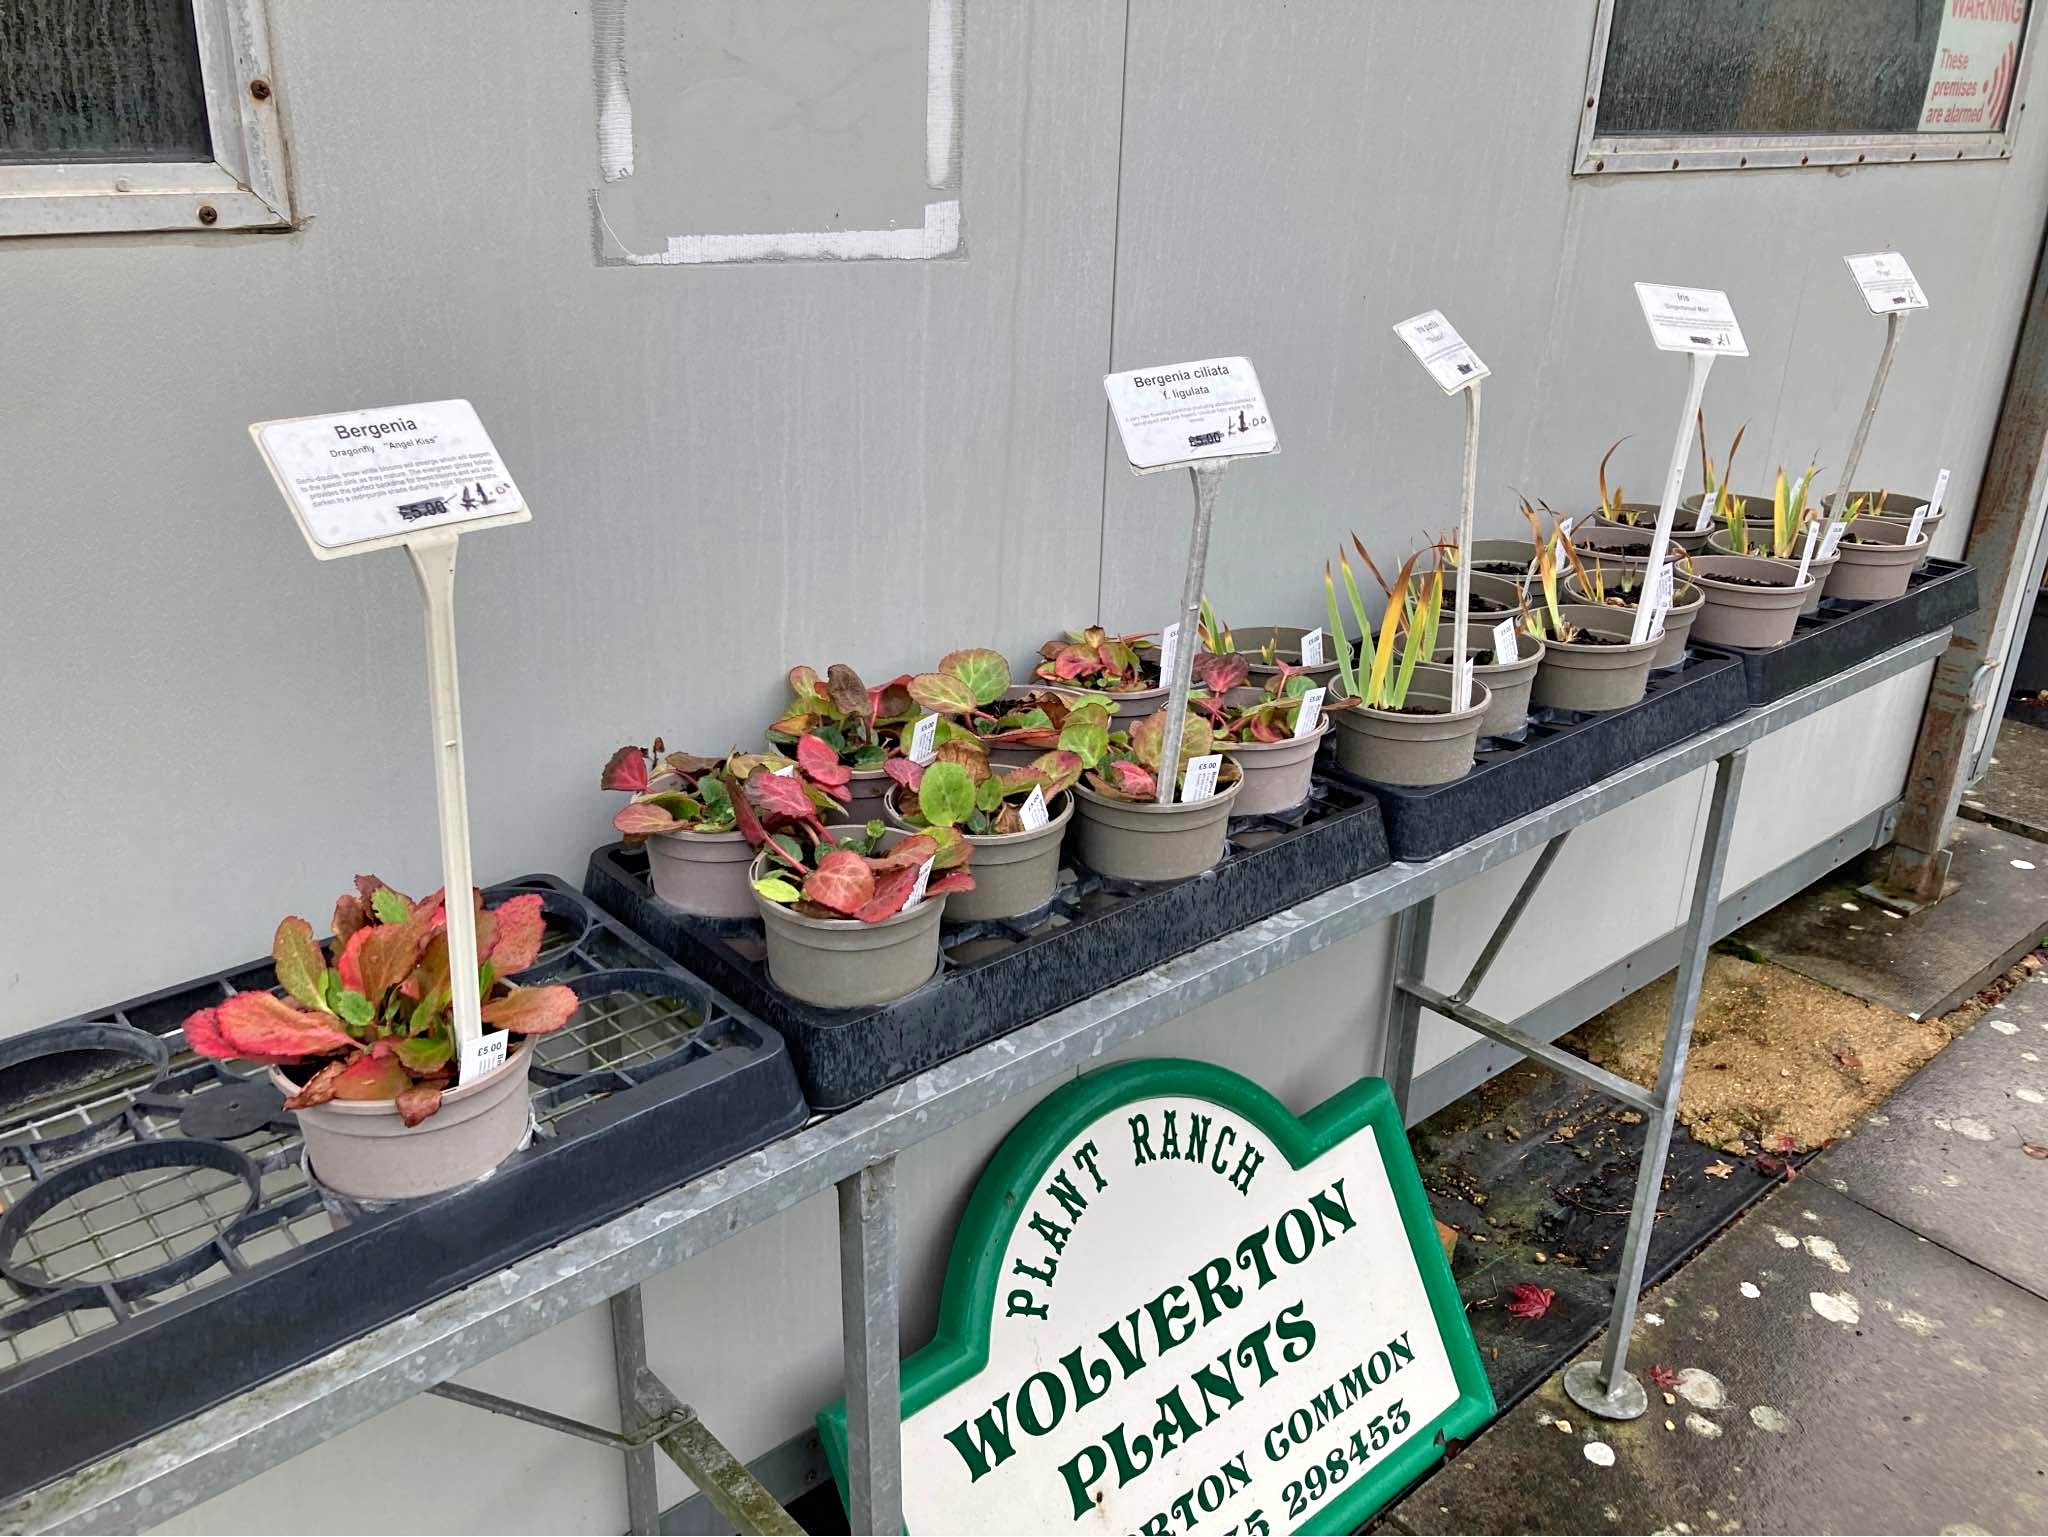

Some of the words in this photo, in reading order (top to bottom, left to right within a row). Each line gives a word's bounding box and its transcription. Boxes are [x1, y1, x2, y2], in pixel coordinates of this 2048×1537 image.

[1952, 0, 2021, 24] WARNING
[1941, 48, 1969, 70] These
[1931, 77, 1977, 101] premises
[1925, 107, 1943, 123] are
[1944, 103, 1984, 123] alarmed
[1134, 370, 1190, 388] Bergenia
[1194, 365, 1229, 379] ciliata
[1173, 385, 1209, 400] ligulata
[333, 418, 417, 440] Bergenia
[329, 444, 375, 459] Dragonfly
[1005, 1140, 1108, 1320] PLANT
[1128, 1109, 1265, 1196] RANCH
[943, 1178, 1357, 1484] WOLVERTON
[1058, 1300, 1317, 1521] PLANTS
[1128, 1450, 1252, 1536] RTON
[1264, 1331, 1416, 1462] COMMON
[1282, 1398, 1411, 1521] 298453
